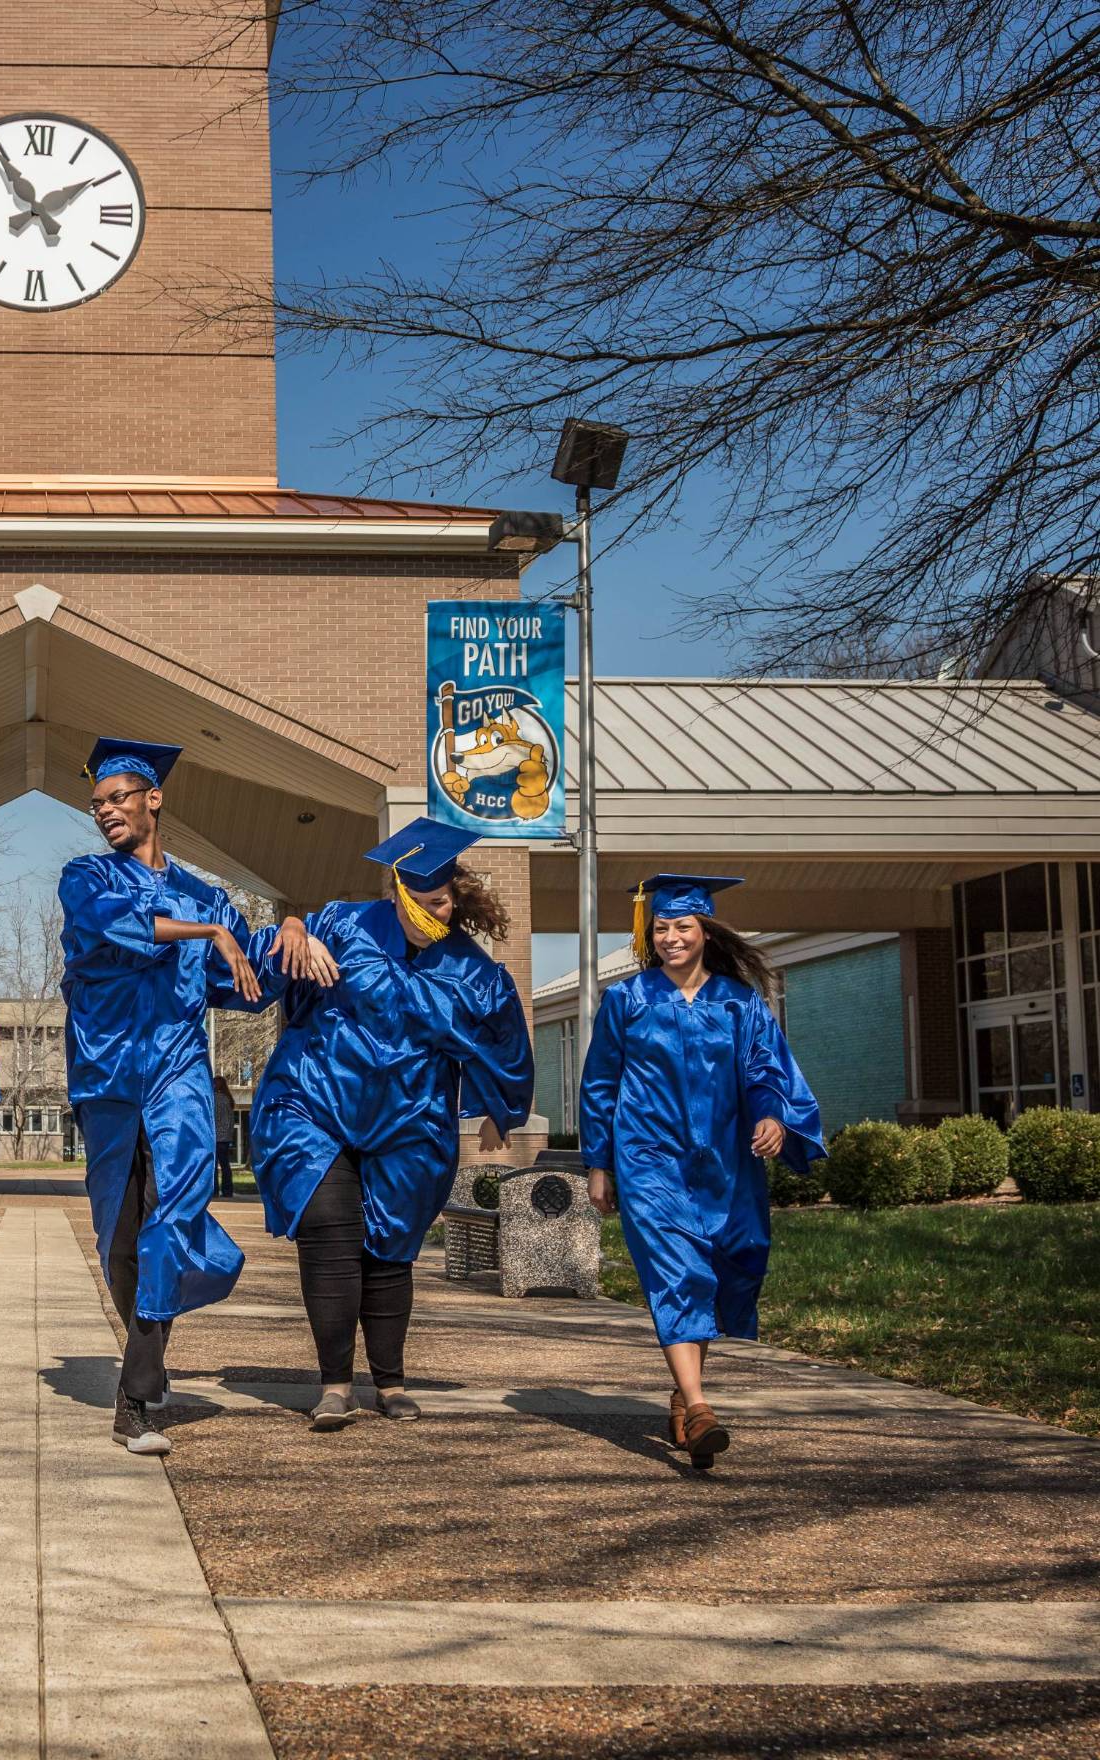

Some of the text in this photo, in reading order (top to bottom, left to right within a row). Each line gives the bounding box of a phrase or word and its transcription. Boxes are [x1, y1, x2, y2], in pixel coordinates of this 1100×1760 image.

[23, 125, 56, 156] XII
[451, 617, 542, 639] FIND YOUR
[463, 643, 528, 677] PATH
[457, 692, 515, 726] GO YOU!
[476, 793, 506, 808] HCC
